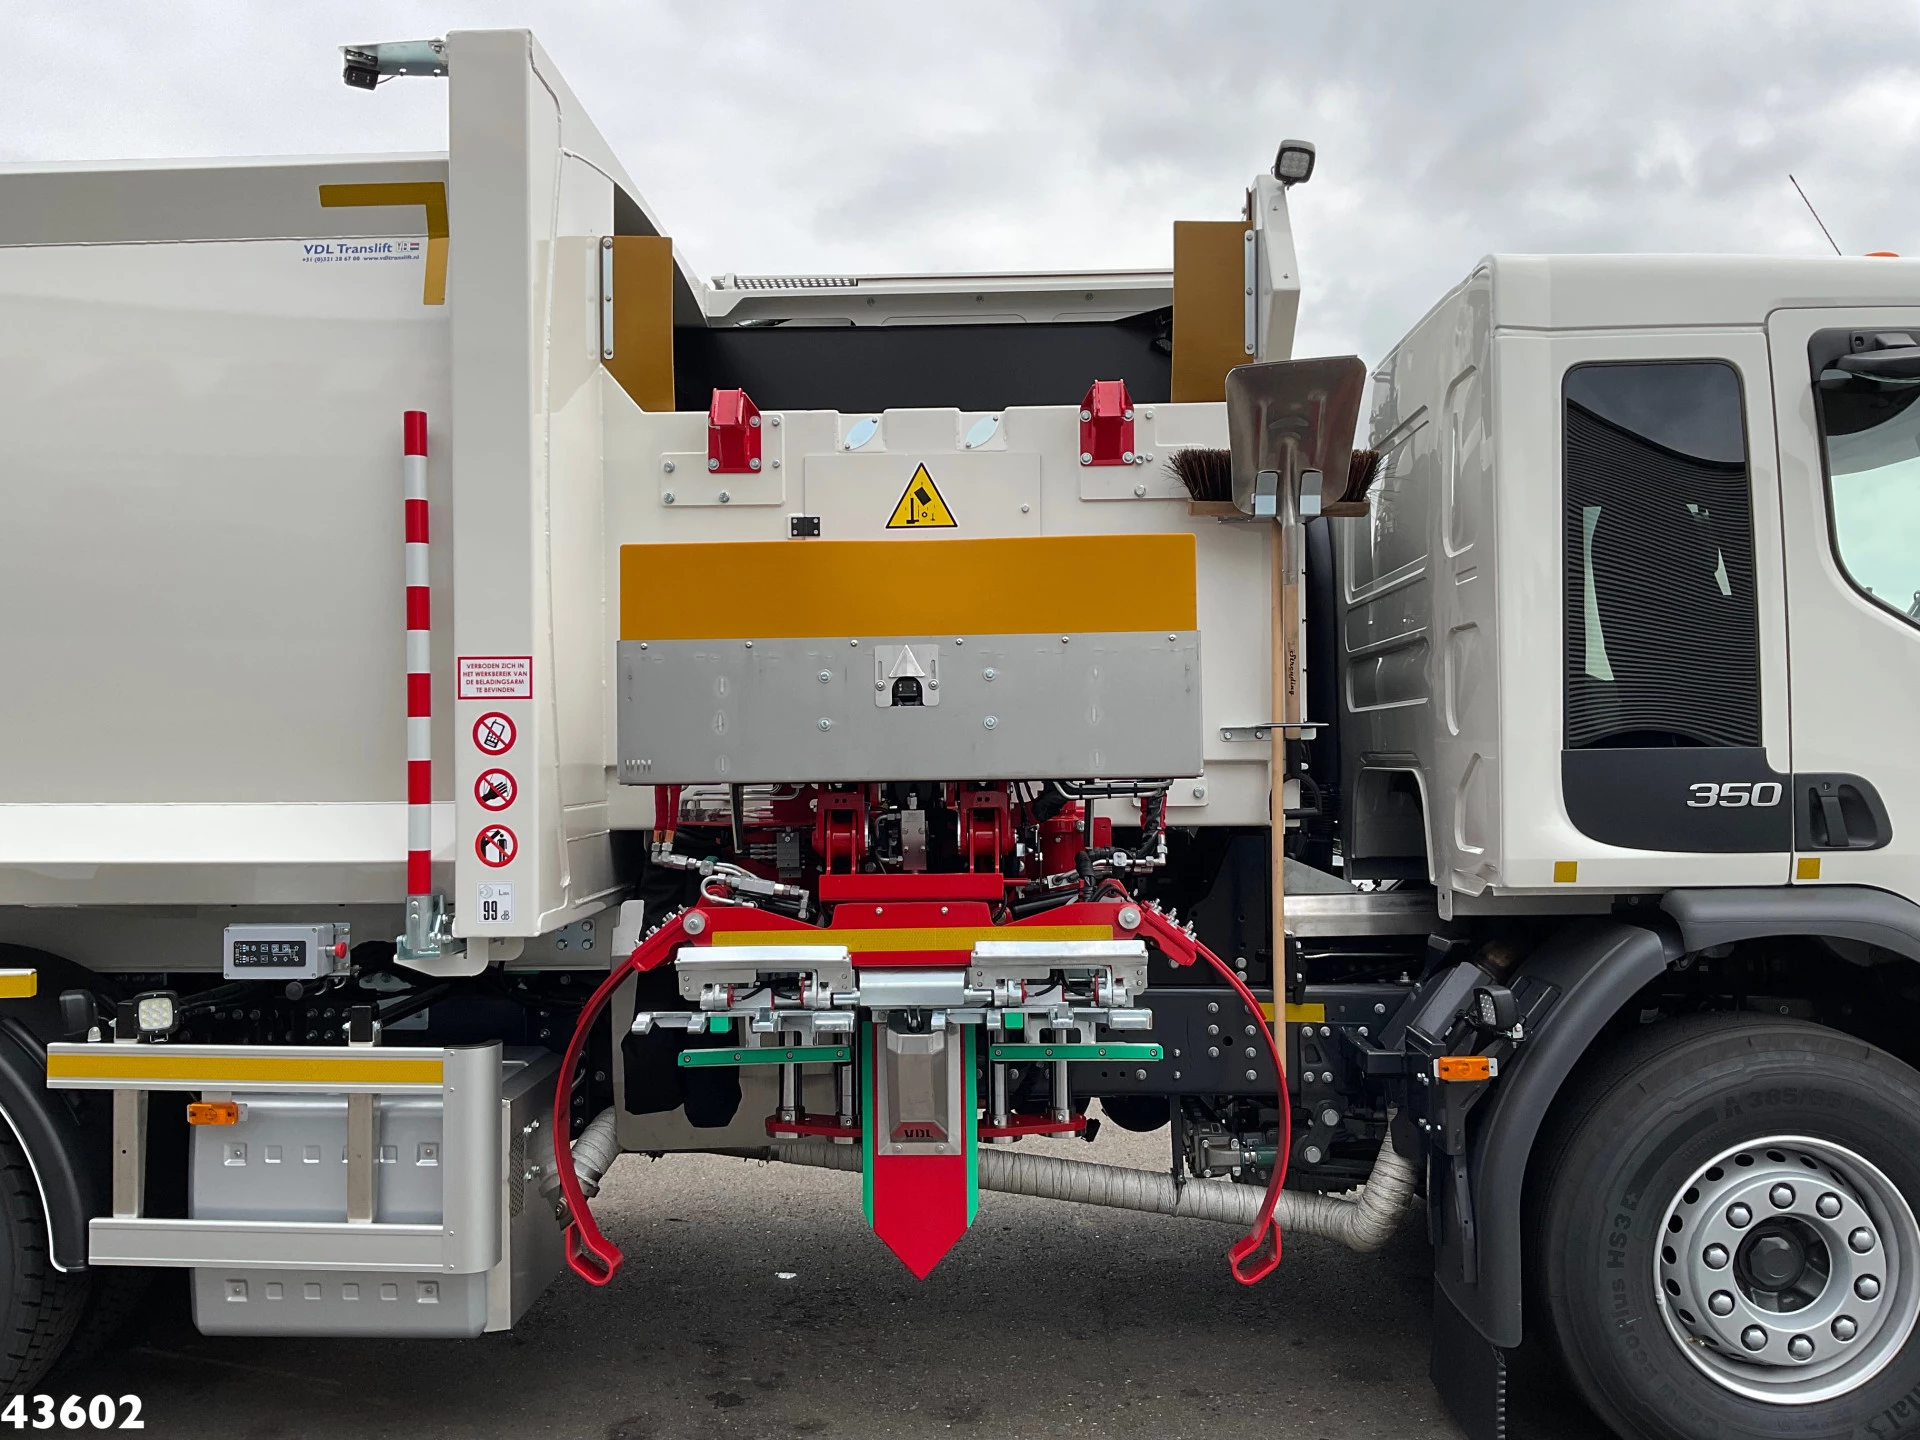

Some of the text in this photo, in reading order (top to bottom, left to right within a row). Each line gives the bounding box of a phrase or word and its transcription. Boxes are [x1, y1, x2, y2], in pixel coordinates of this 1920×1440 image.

[303, 244, 334, 255] VDL
[337, 242, 393, 254] Translift
[1686, 782, 1783, 807] 350
[483, 900, 510, 921] 99 dB
